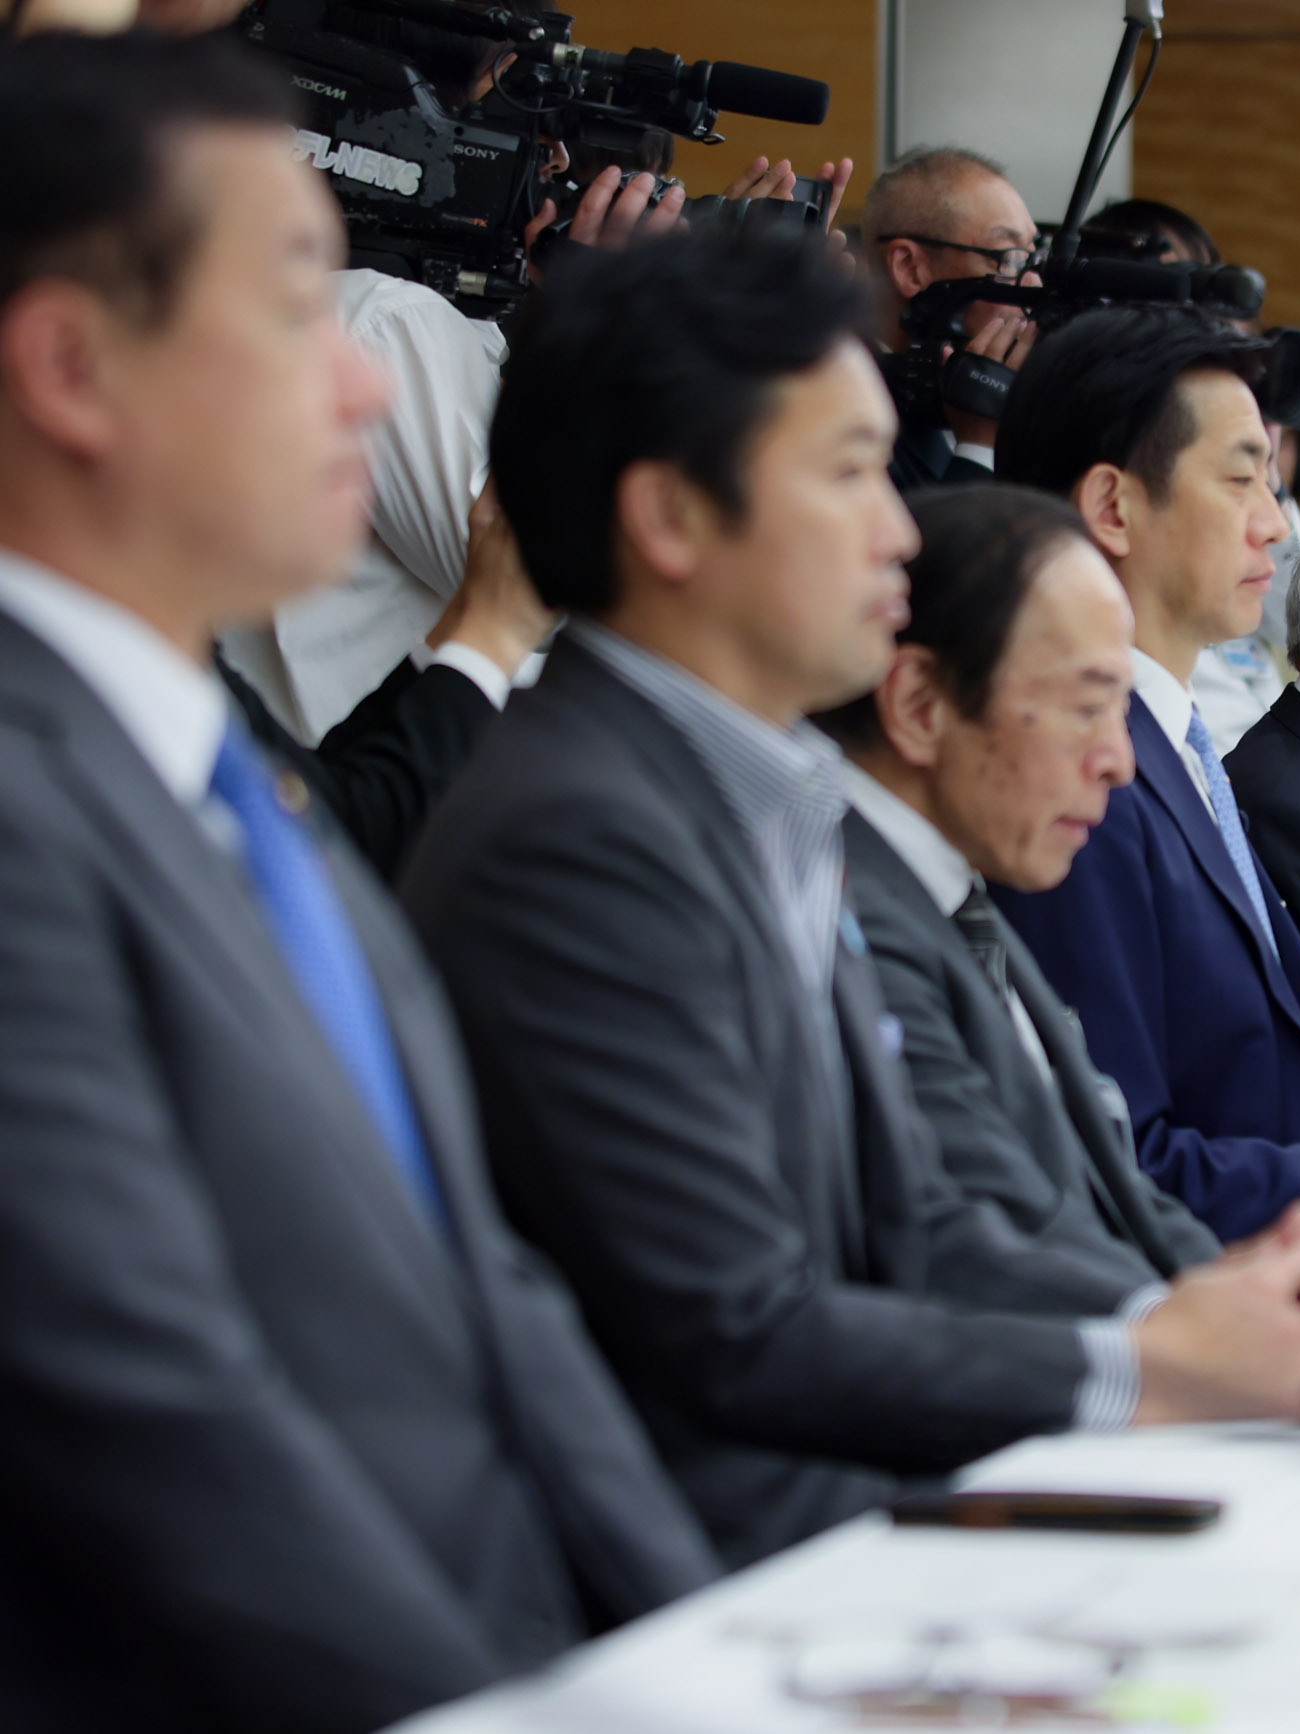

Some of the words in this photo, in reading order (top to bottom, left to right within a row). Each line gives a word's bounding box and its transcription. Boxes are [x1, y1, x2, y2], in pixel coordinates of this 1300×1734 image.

[290, 74, 347, 101] XDCAM
[288, 126, 422, 196] テレNEWS
[453, 144, 500, 161] SONY
[969, 369, 1009, 393] SONY
